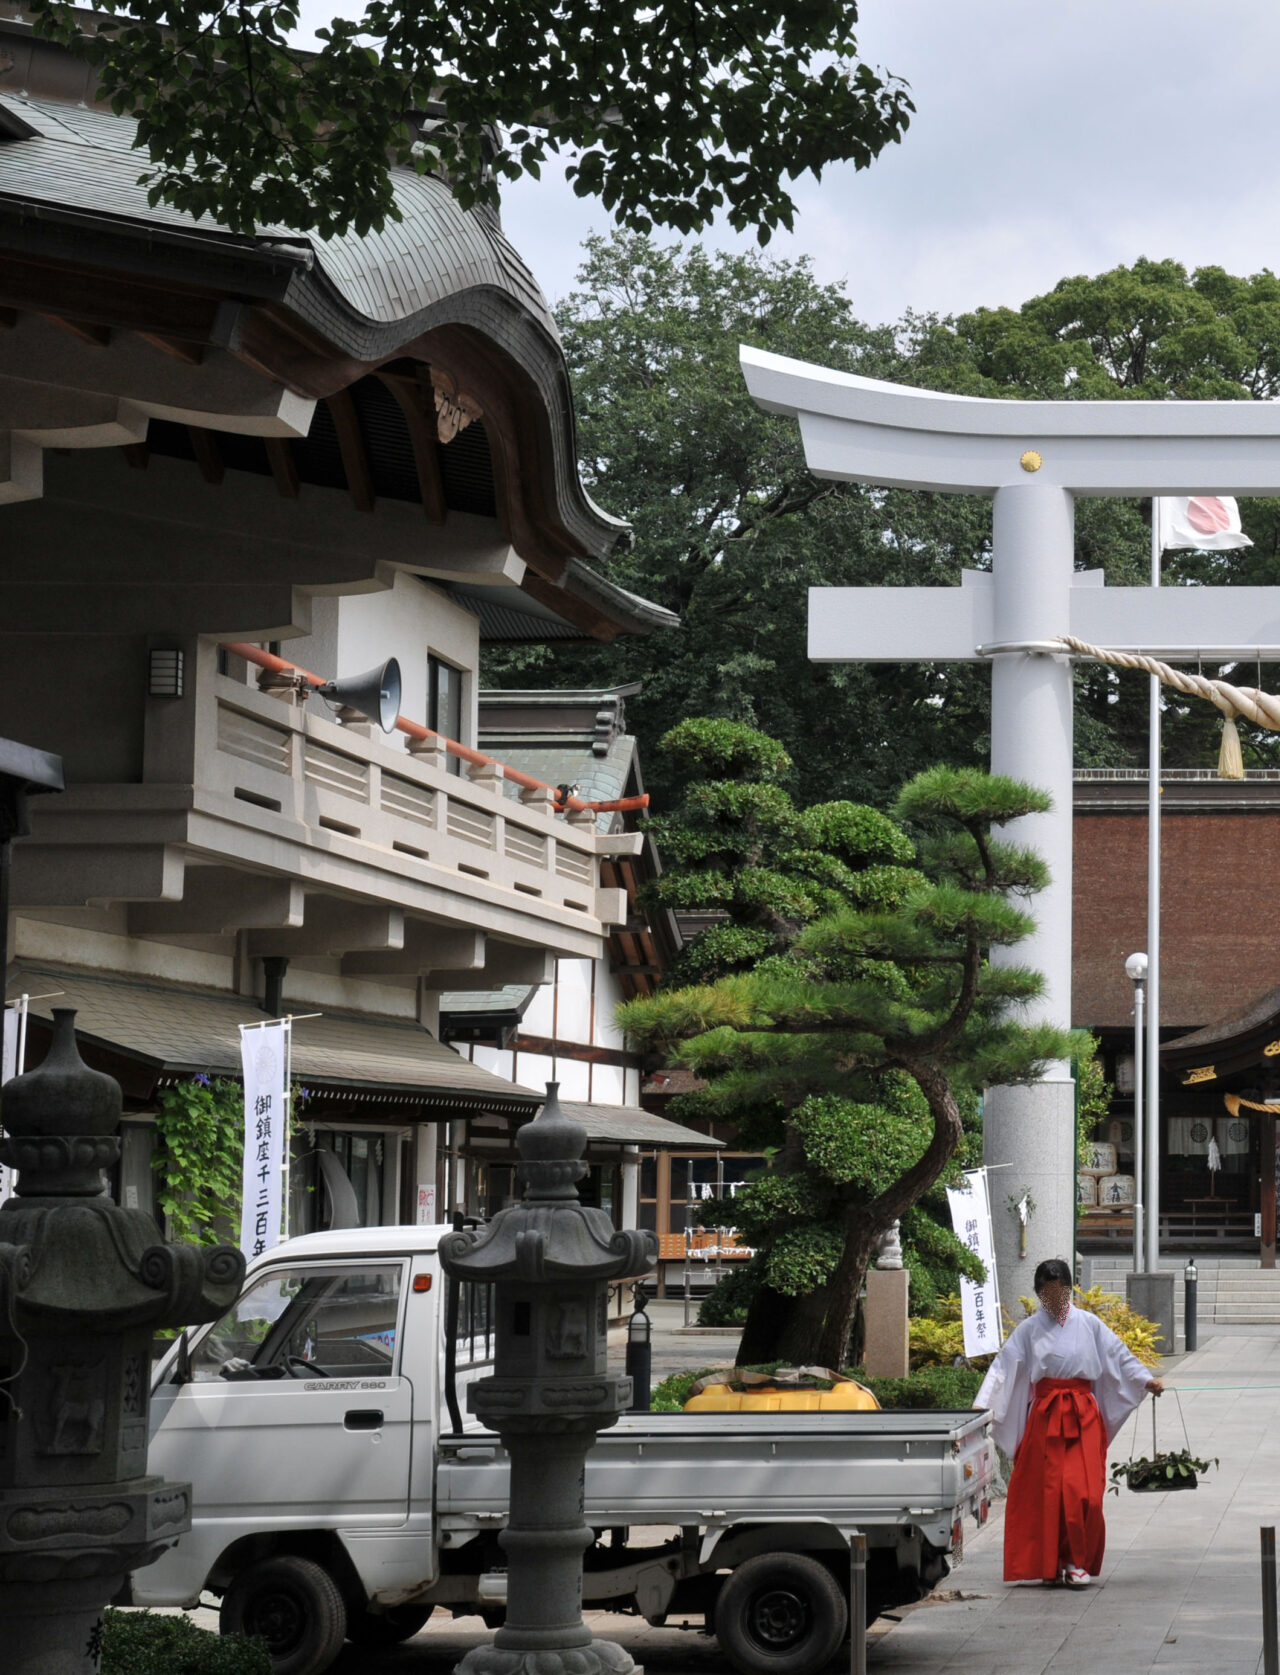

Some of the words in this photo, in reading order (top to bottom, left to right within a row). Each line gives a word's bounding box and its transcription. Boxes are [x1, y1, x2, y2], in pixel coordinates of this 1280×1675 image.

[252, 1095, 272, 1257] 御鎮座千三百年
[965, 1219, 987, 1339] 御鎮百年祭
[304, 1381, 360, 1391] CARRY
